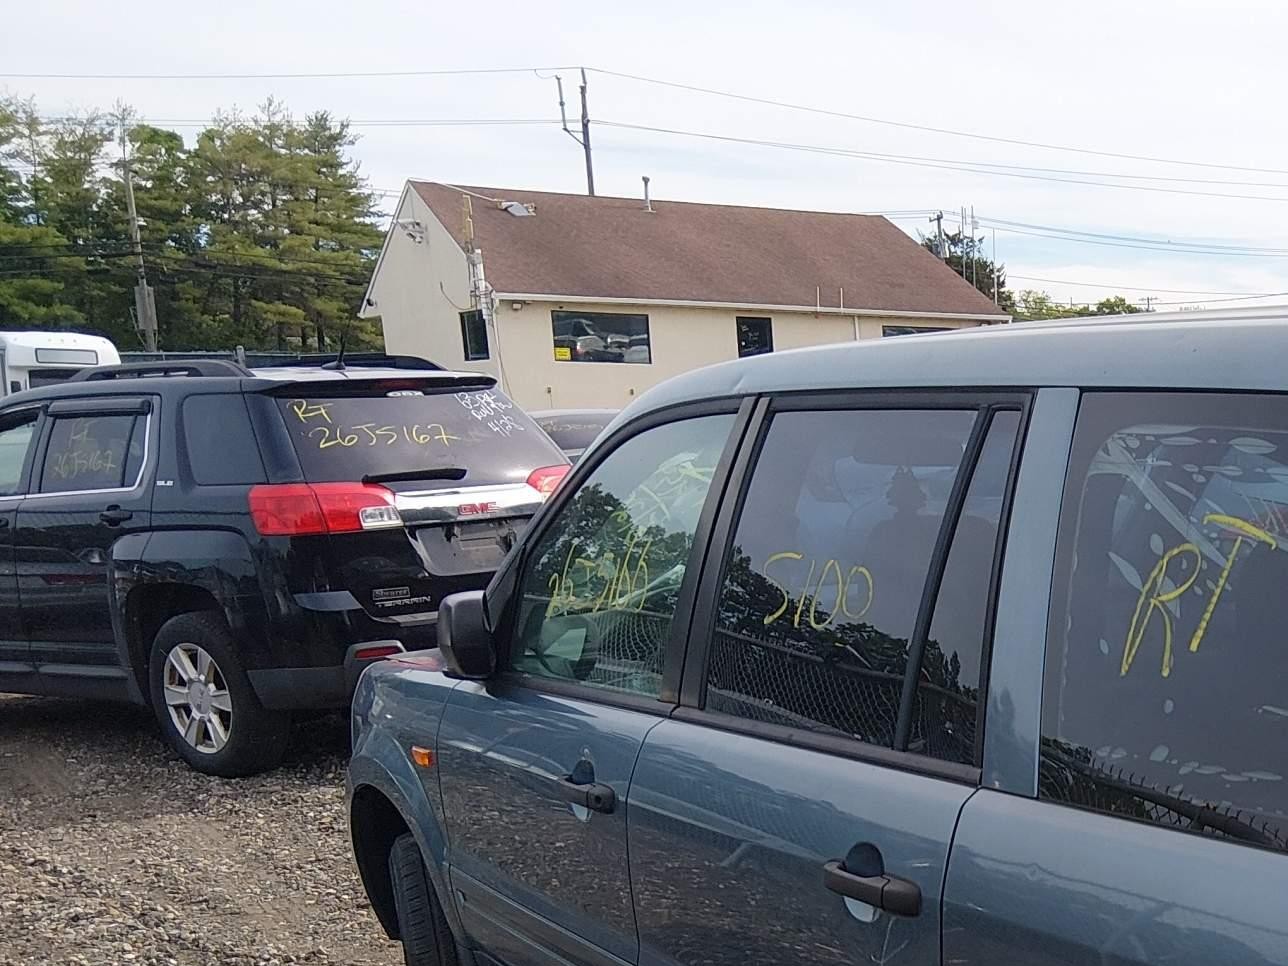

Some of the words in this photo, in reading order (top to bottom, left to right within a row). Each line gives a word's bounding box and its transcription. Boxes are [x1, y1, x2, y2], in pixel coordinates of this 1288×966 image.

[286, 398, 334, 425] RT
[458, 502, 500, 516] GMC
[1120, 513, 1278, 677] RT
